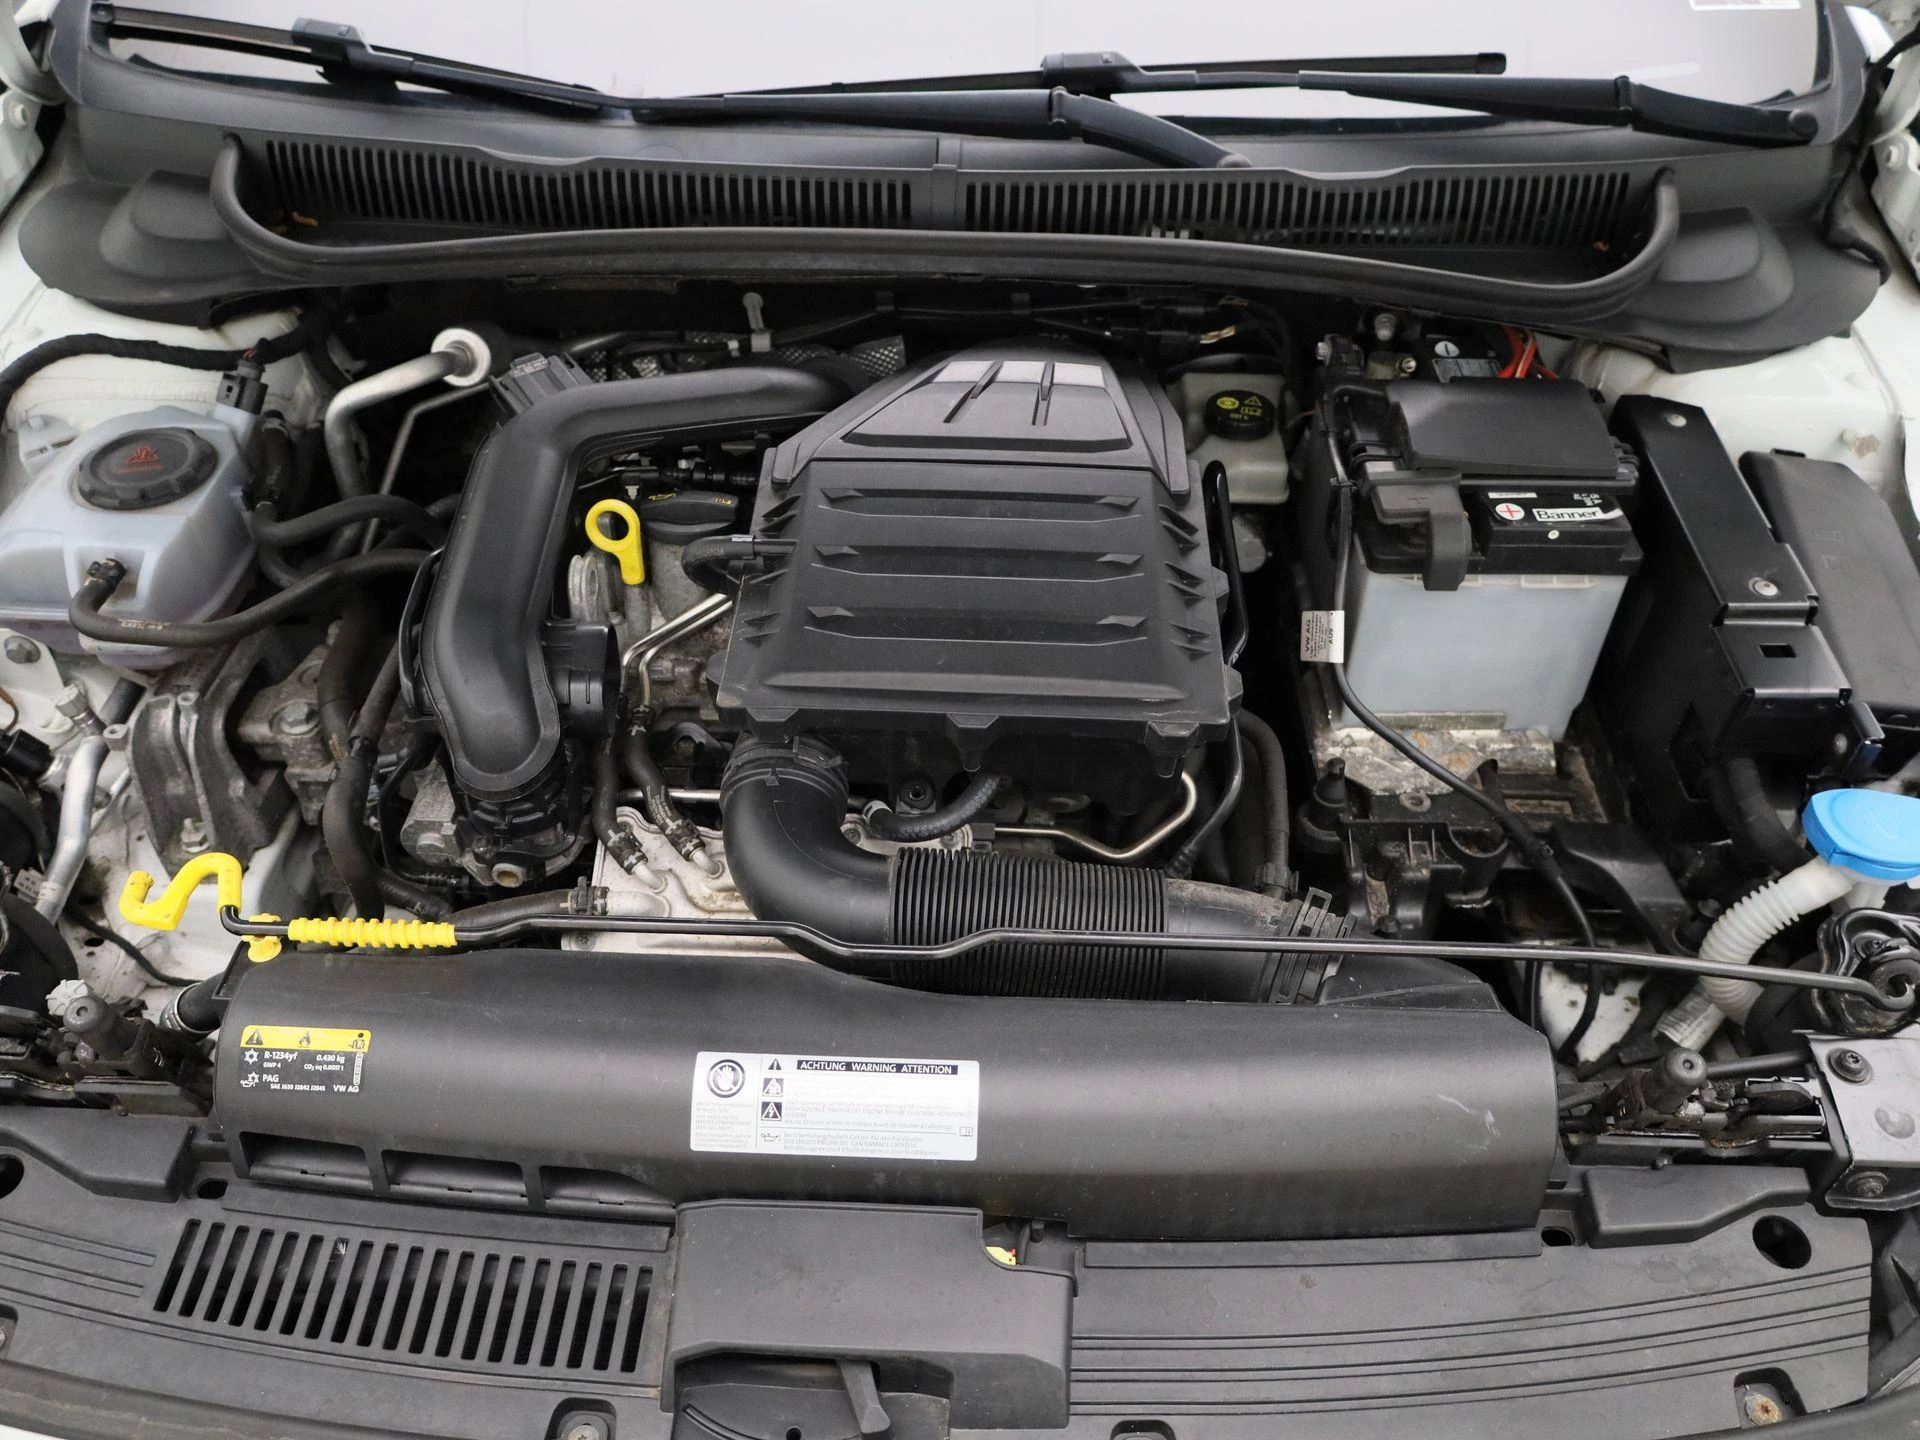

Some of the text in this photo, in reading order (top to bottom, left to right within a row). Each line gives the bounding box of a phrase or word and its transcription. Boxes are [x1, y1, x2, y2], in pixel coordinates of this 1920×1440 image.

[1536, 509, 1599, 520] Banner
[264, 1052, 298, 1063] R-1234yf
[316, 1054, 346, 1064] 0.430 kg
[800, 1061, 952, 1074] ACHTUNG WARNING ATTENTION
[262, 1074, 279, 1082] PAG
[333, 1084, 360, 1093] VW AG
